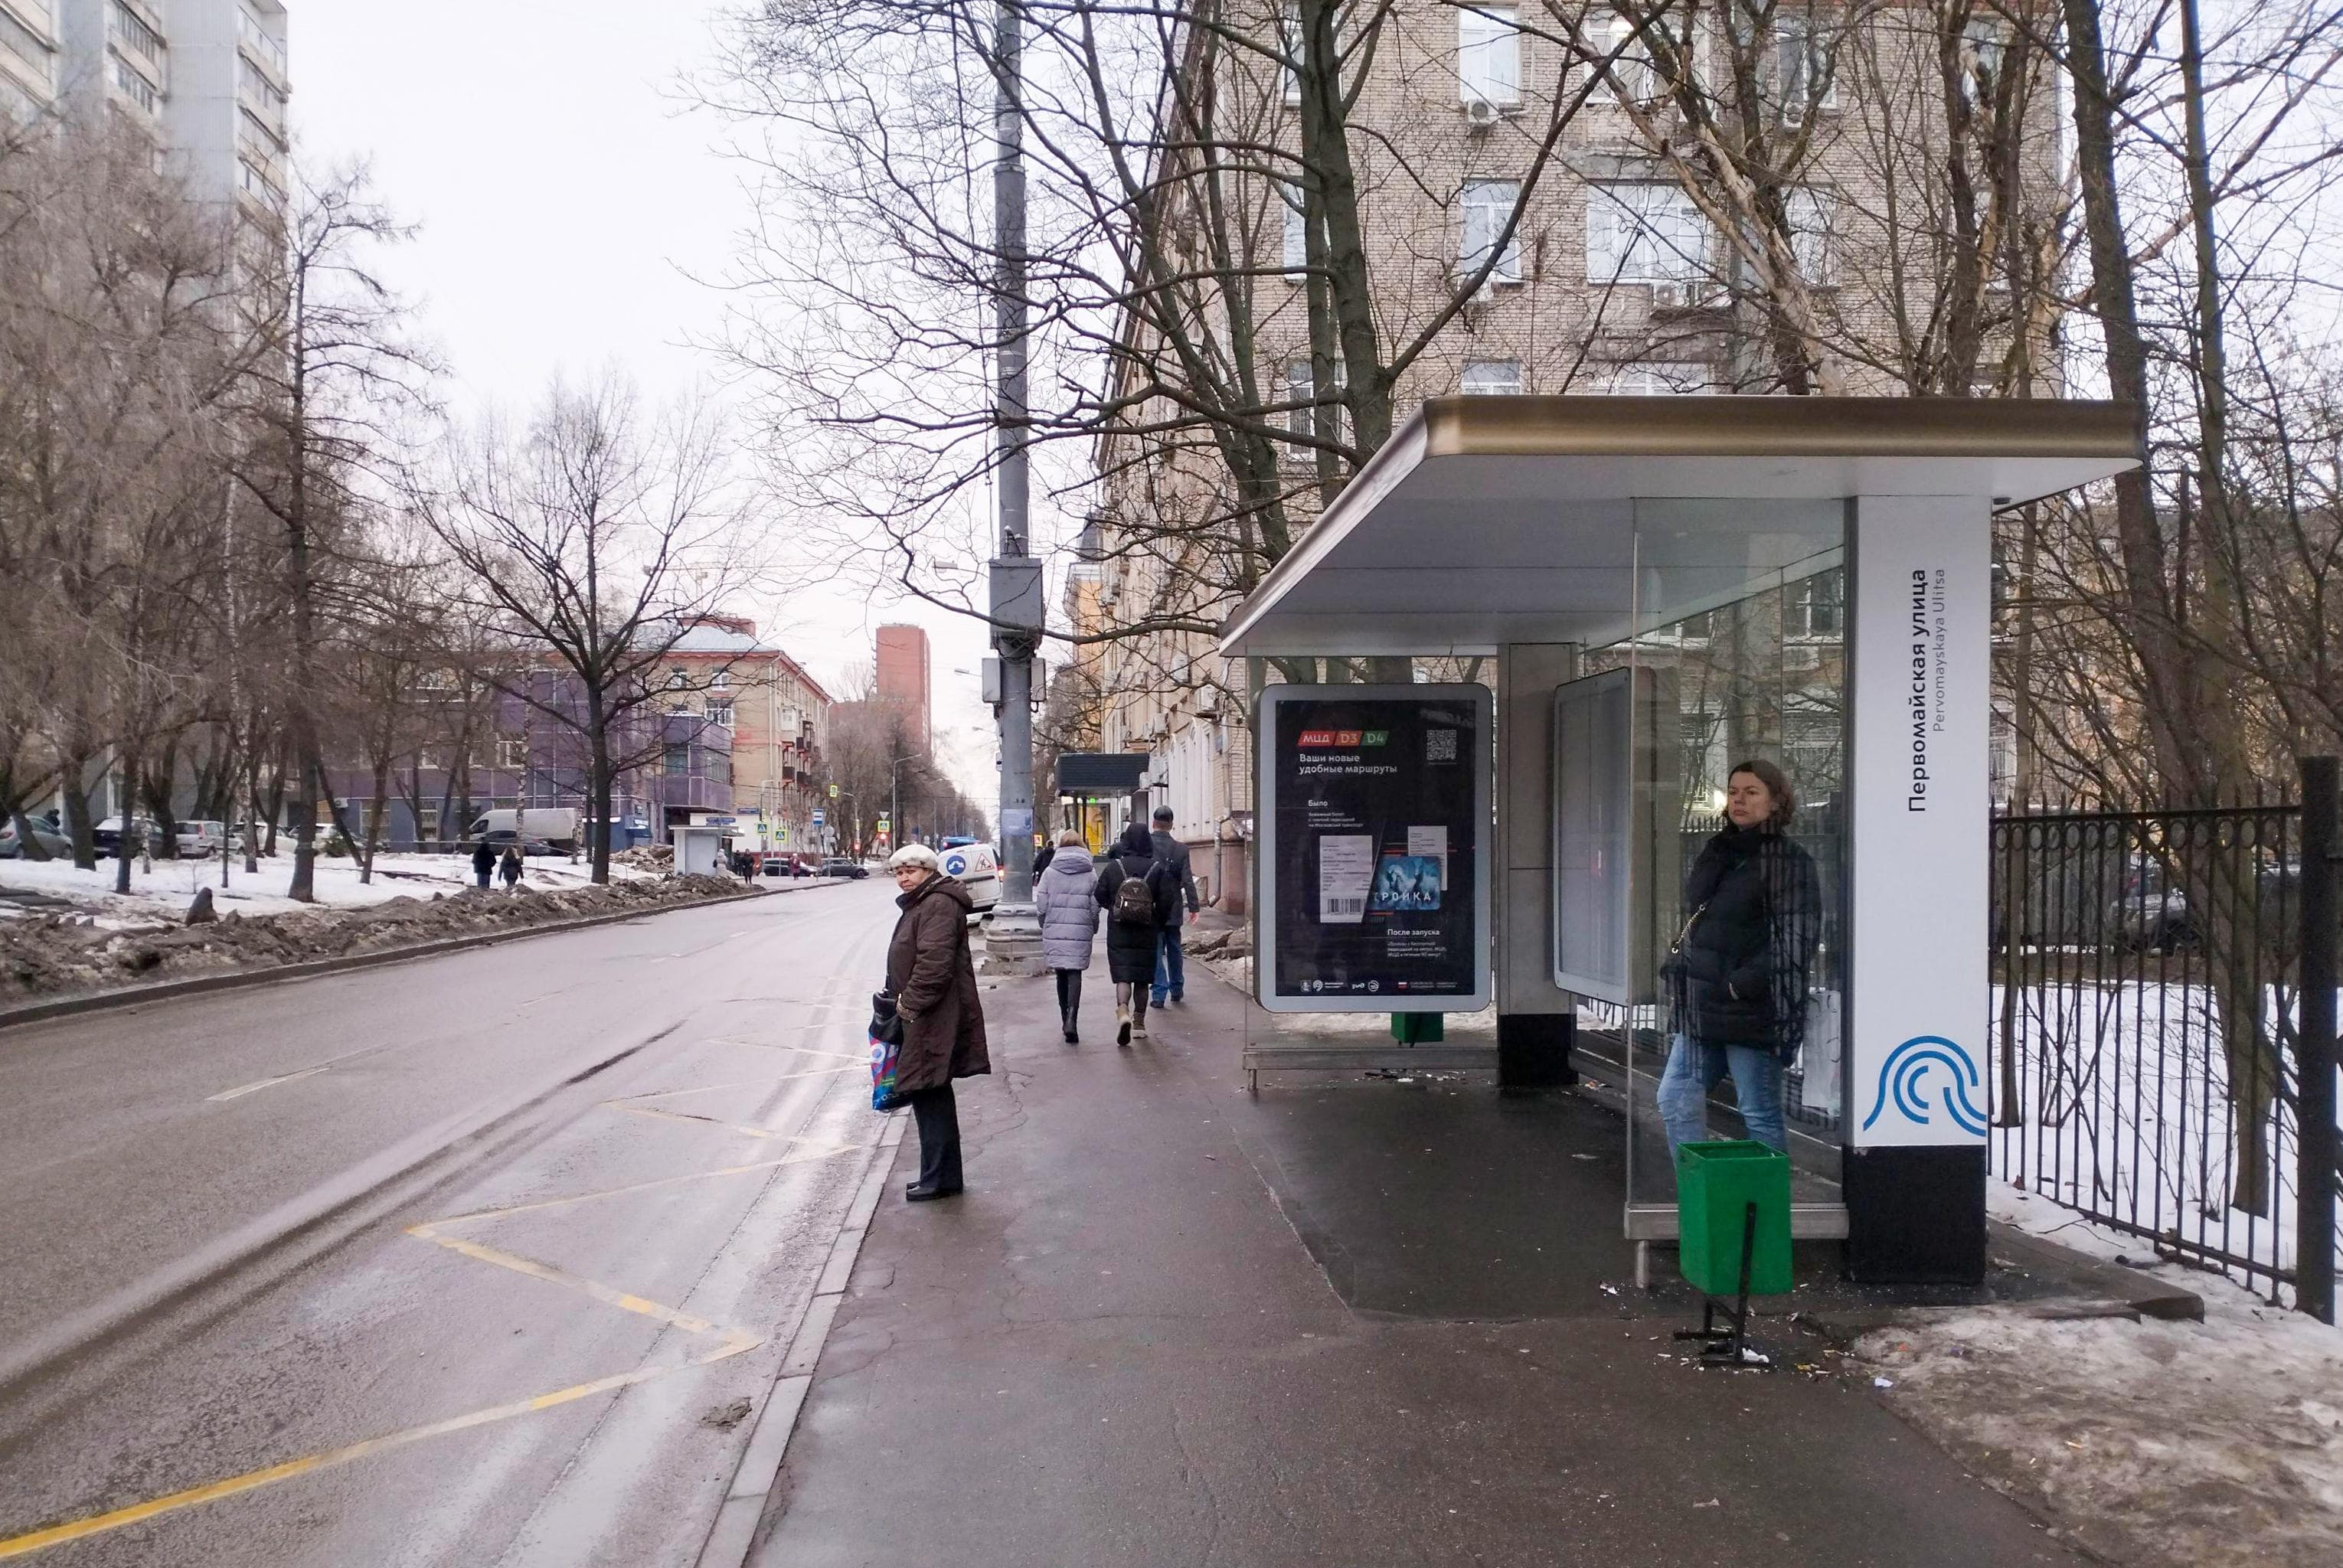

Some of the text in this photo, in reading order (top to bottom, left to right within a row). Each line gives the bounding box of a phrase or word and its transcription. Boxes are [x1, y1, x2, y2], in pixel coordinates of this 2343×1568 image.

[1932, 569, 1947, 732] Pervomayskaya Ulitsa
[1909, 570, 1930, 812] Первомайская улица
[1303, 733, 1384, 743] МЦД D3 D4
[1299, 753, 1326, 762] Ваши
[1299, 764, 1397, 774] удобные маршруты
